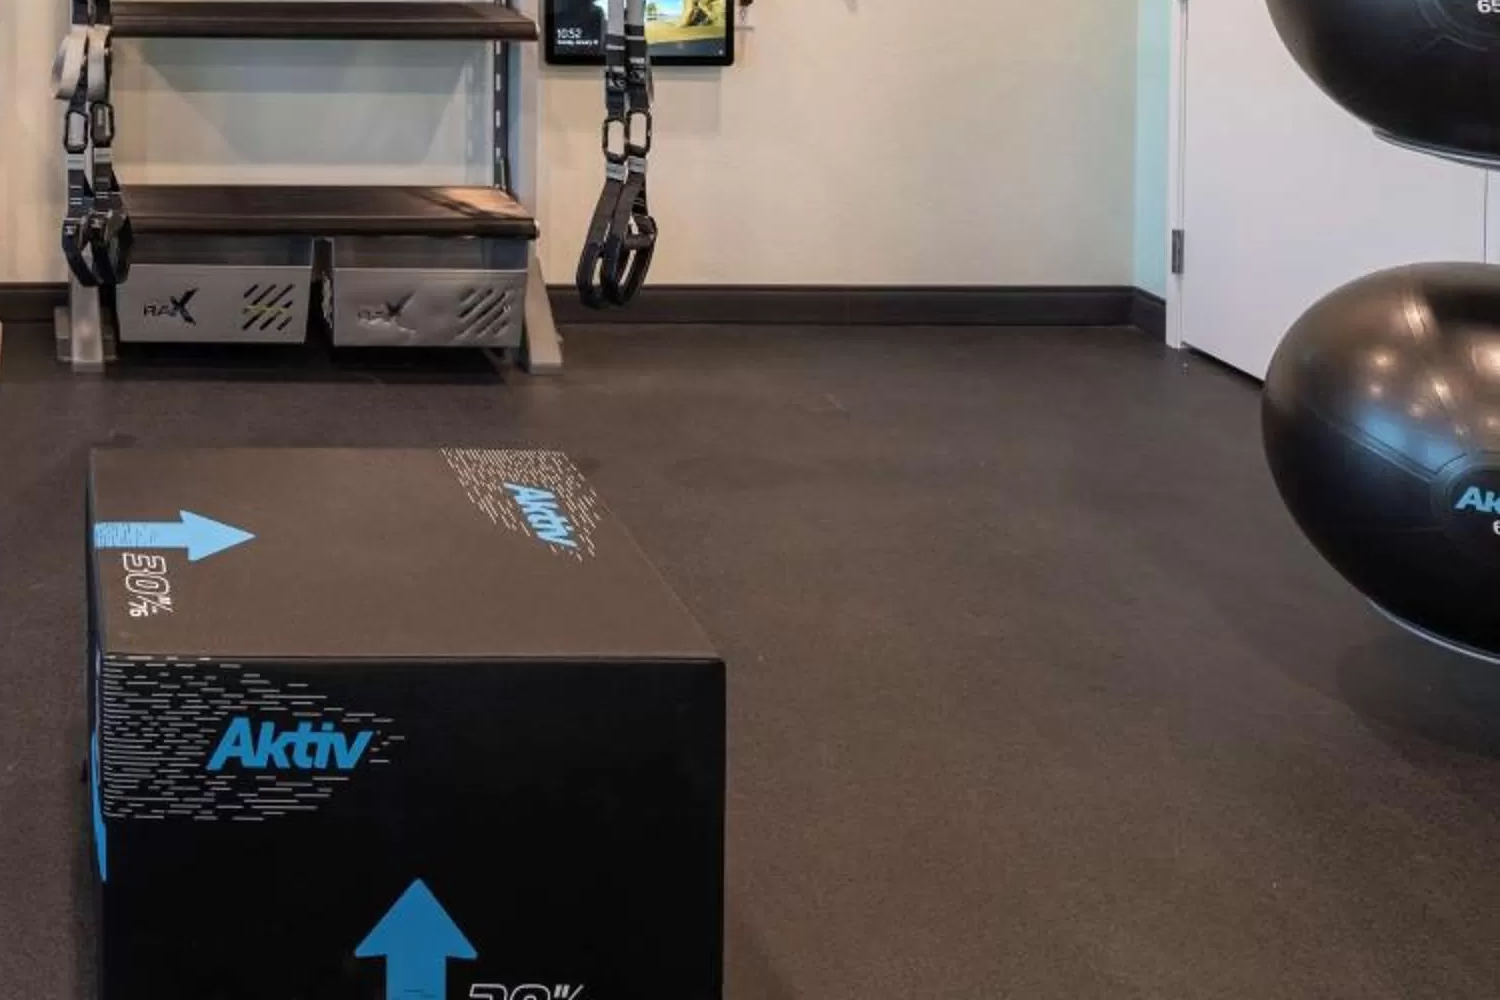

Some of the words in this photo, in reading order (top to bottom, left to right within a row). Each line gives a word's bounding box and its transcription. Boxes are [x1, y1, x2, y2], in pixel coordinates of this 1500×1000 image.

[143, 287, 199, 326] RAX
[502, 482, 579, 548] Aktiv
[205, 717, 372, 771] Aktiv
